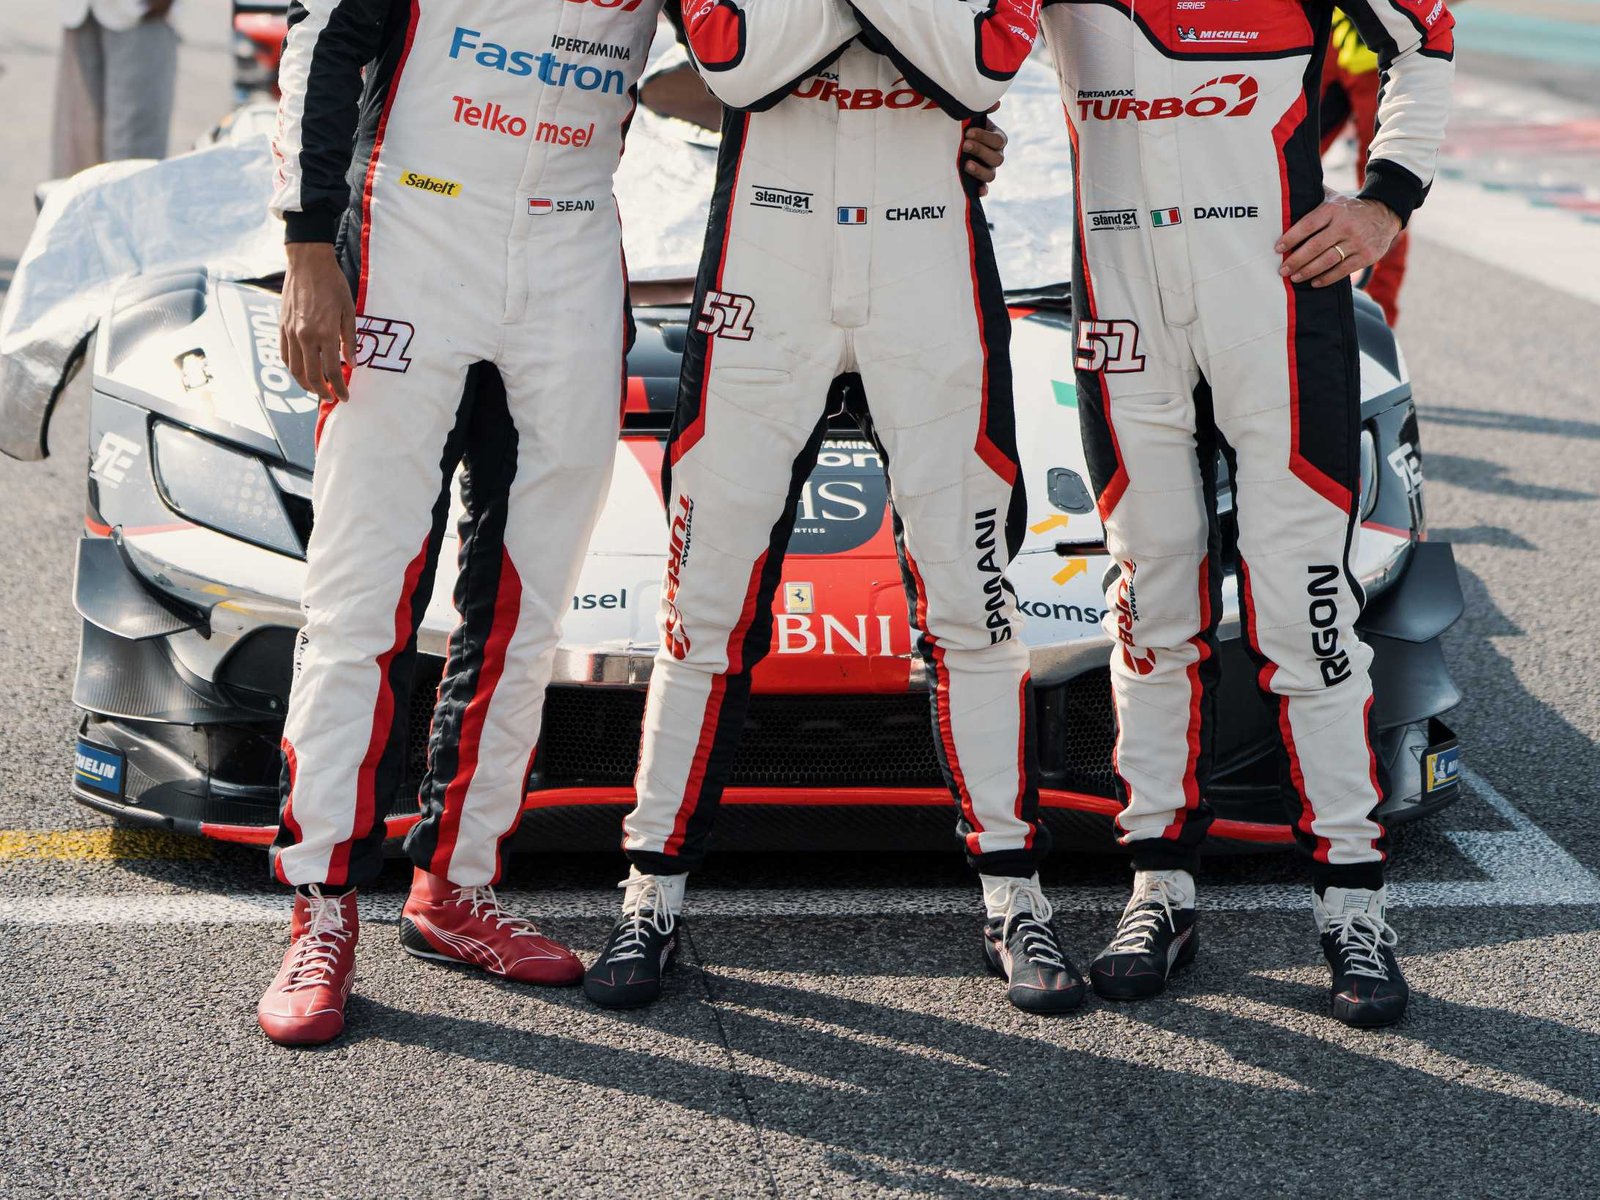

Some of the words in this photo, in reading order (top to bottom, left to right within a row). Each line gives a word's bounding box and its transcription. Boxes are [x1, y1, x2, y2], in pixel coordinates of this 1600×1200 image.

[1176, 1, 1206, 10] SERIES
[1200, 30, 1259, 40] MICHELIN
[448, 26, 624, 95] Fastron
[790, 79, 926, 110] URBO
[1077, 88, 1135, 99] PERTAMAX
[1076, 96, 1227, 122] TURBO
[404, 173, 457, 196] Sabelt
[556, 199, 595, 212] SEAN
[884, 205, 946, 222] CHARLY
[1193, 206, 1259, 220] DAVIDE
[696, 289, 755, 342] 51
[1074, 319, 1146, 374] 51
[775, 613, 893, 656] BNI
[1307, 565, 1352, 687] RIGON
[75, 752, 116, 779] HELIN
